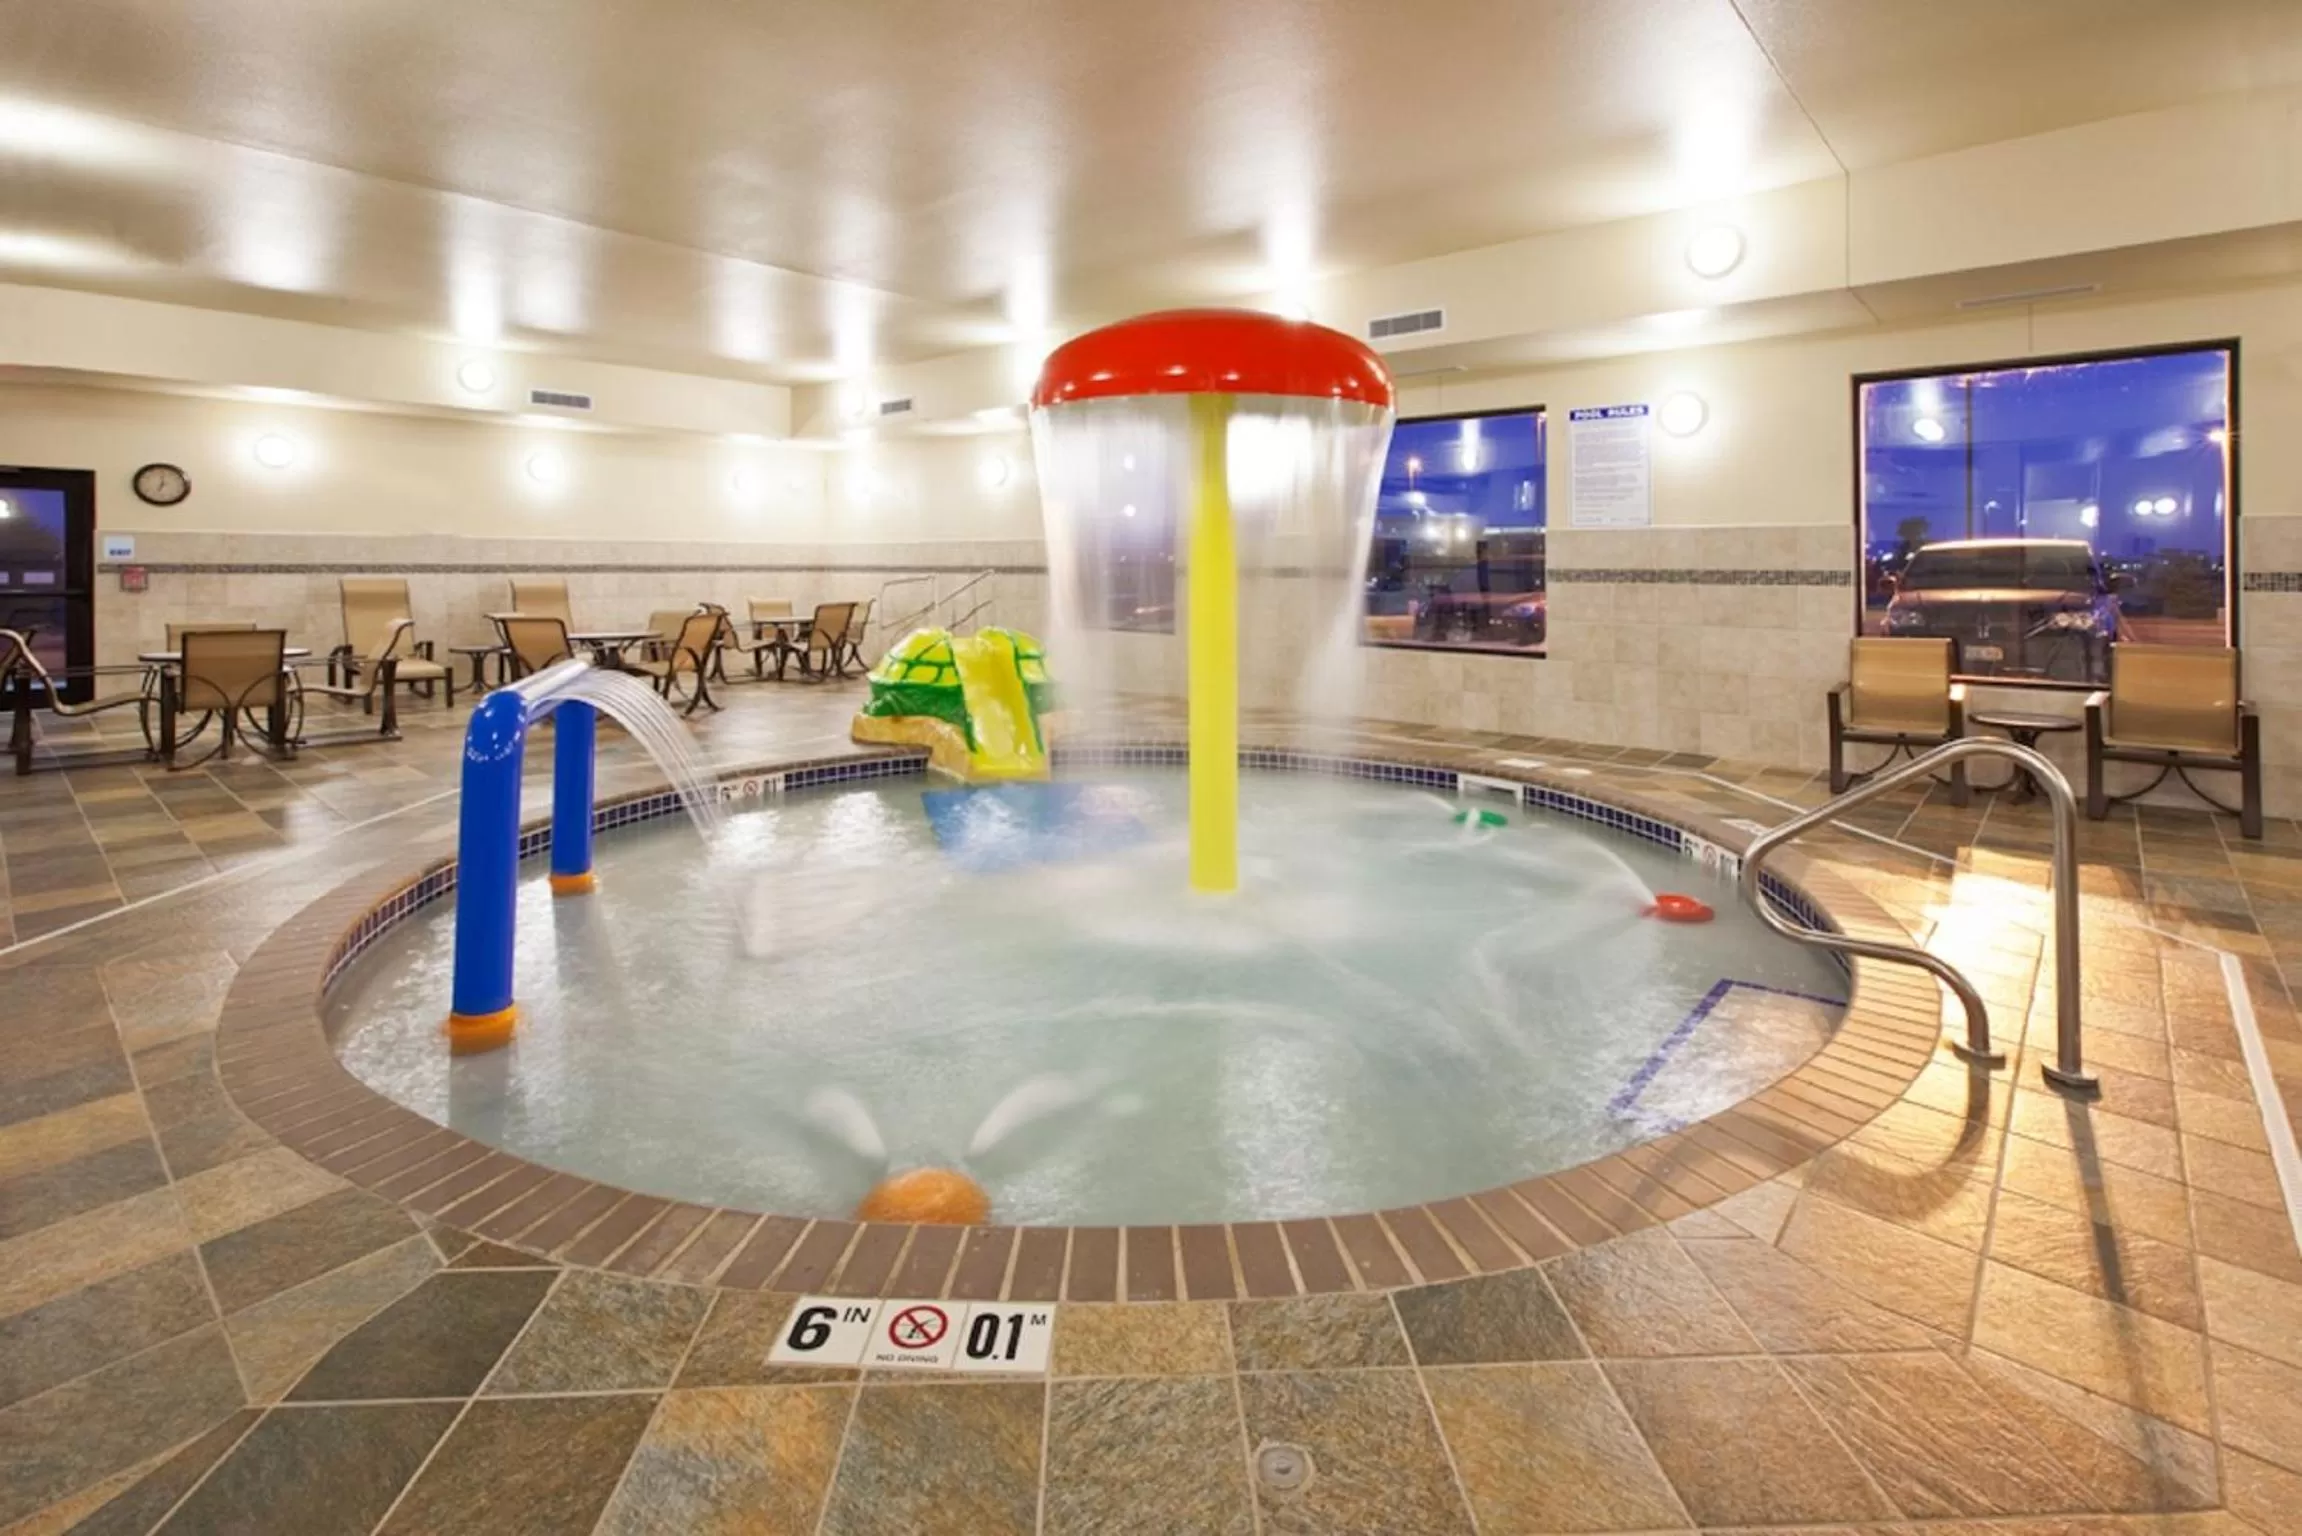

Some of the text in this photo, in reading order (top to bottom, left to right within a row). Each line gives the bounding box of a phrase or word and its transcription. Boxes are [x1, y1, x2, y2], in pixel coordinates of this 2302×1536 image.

[787, 1305, 873, 1351] 6 IN
[966, 1312, 1048, 1361] 0.1 M
[875, 1354, 939, 1364] NO DIVING
